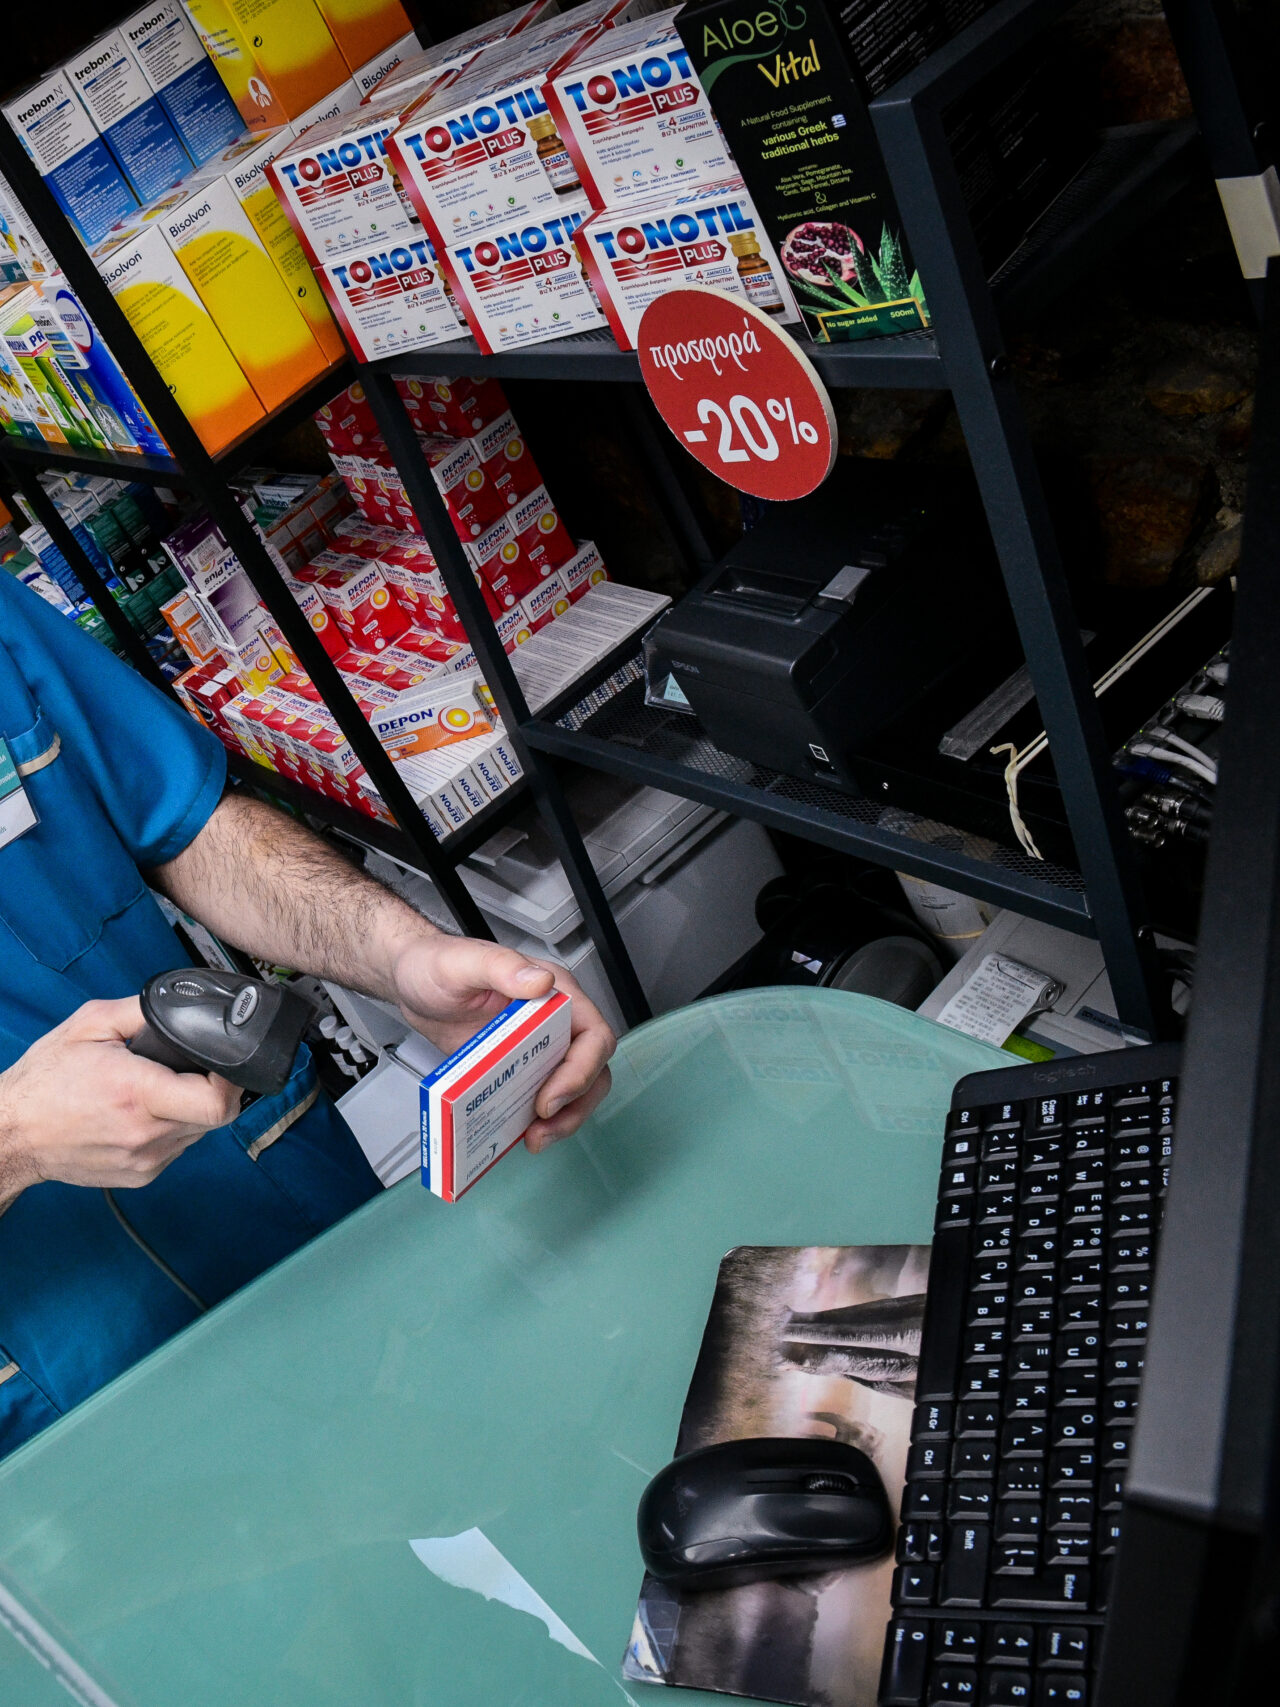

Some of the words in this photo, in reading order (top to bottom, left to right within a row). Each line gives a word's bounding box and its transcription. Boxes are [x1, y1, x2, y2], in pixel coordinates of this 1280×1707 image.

[129, 11, 165, 41] trebon
[704, 11, 779, 57] Aloe
[74, 51, 111, 81] trebon
[757, 38, 820, 88] Vital
[564, 48, 692, 111] TONOT
[17, 93, 55, 123] trebon
[656, 86, 694, 110] PLUS
[747, 113, 770, 126] Natural
[771, 107, 789, 119] Food
[789, 95, 832, 113] Supplement
[404, 87, 549, 160] TONOTIL
[669, 117, 677, 127] 4
[762, 131, 797, 146] various
[798, 121, 827, 136] Greek
[772, 115, 808, 130] containing
[487, 130, 521, 154] PLUS
[761, 140, 809, 160] traditional
[811, 132, 839, 147] herbs
[235, 156, 275, 188] Bisolvon
[350, 166, 380, 185] PLUS
[499, 159, 507, 169] 4
[169, 206, 211, 238] Bisolvon
[595, 202, 755, 259] TONOTIL
[332, 239, 437, 289] TONOTI
[534, 252, 567, 271] PLUS
[684, 243, 721, 263] PLUS
[402, 270, 431, 288] PLUS
[545, 278, 552, 287] 4
[696, 270, 704, 280] 4
[837, 319, 855, 328] sugar
[856, 315, 878, 324] added
[890, 308, 914, 318] 500ml
[649, 317, 761, 380] προσφορά
[482, 419, 511, 446] DEPON
[484, 424, 516, 452] MAXIMUM
[683, 394, 819, 463] -20%
[442, 450, 470, 477] DEPON
[444, 455, 475, 483] MAXIMUM
[515, 494, 546, 520] DEPON
[517, 498, 549, 526] MAXIMUM
[477, 523, 506, 551] DEPON
[479, 528, 510, 557] MAXIMUM
[567, 551, 595, 577] DEPON
[569, 556, 599, 582] MAXIMUM
[348, 571, 376, 597] DEPON
[350, 576, 380, 602] MAXIMUM
[530, 581, 558, 607] DEPON
[532, 586, 562, 613] MAXIMUM
[497, 610, 520, 633] EPON
[238, 637, 259, 656] DEPON
[387, 649, 410, 660] DEPON
[414, 658, 437, 669] DEPON
[376, 688, 399, 700] DEPON
[378, 709, 433, 733] DEPON
[497, 746, 518, 776] DEPON
[478, 763, 499, 792] DEPON
[459, 778, 481, 808] DEPON
[440, 794, 461, 823] DEPON
[466, 1063, 515, 1117] SIBELIUM
[523, 1051, 529, 1065] 5
[532, 1034, 550, 1057] mg
[1162, 1081, 1170, 1092] Esc
[1094, 1093, 1103, 1104] Tab
[961, 1112, 969, 1123] Ctrl
[1003, 1105, 1011, 1119] Shift
[1076, 1140, 1087, 1148] Q
[1075, 1171, 1087, 1180] W
[951, 1204, 960, 1214] Alt
[928, 1418, 938, 1429] Gr
[930, 1407, 939, 1417] Alt
[924, 1450, 934, 1465] Ctrl
[964, 1530, 974, 1550] Shift
[1064, 1574, 1075, 1599] Enter
[895, 1629, 904, 1642] Ins
[944, 1631, 954, 1646] End
[1015, 1637, 1028, 1647] 4
[1050, 1632, 1060, 1655] Home
